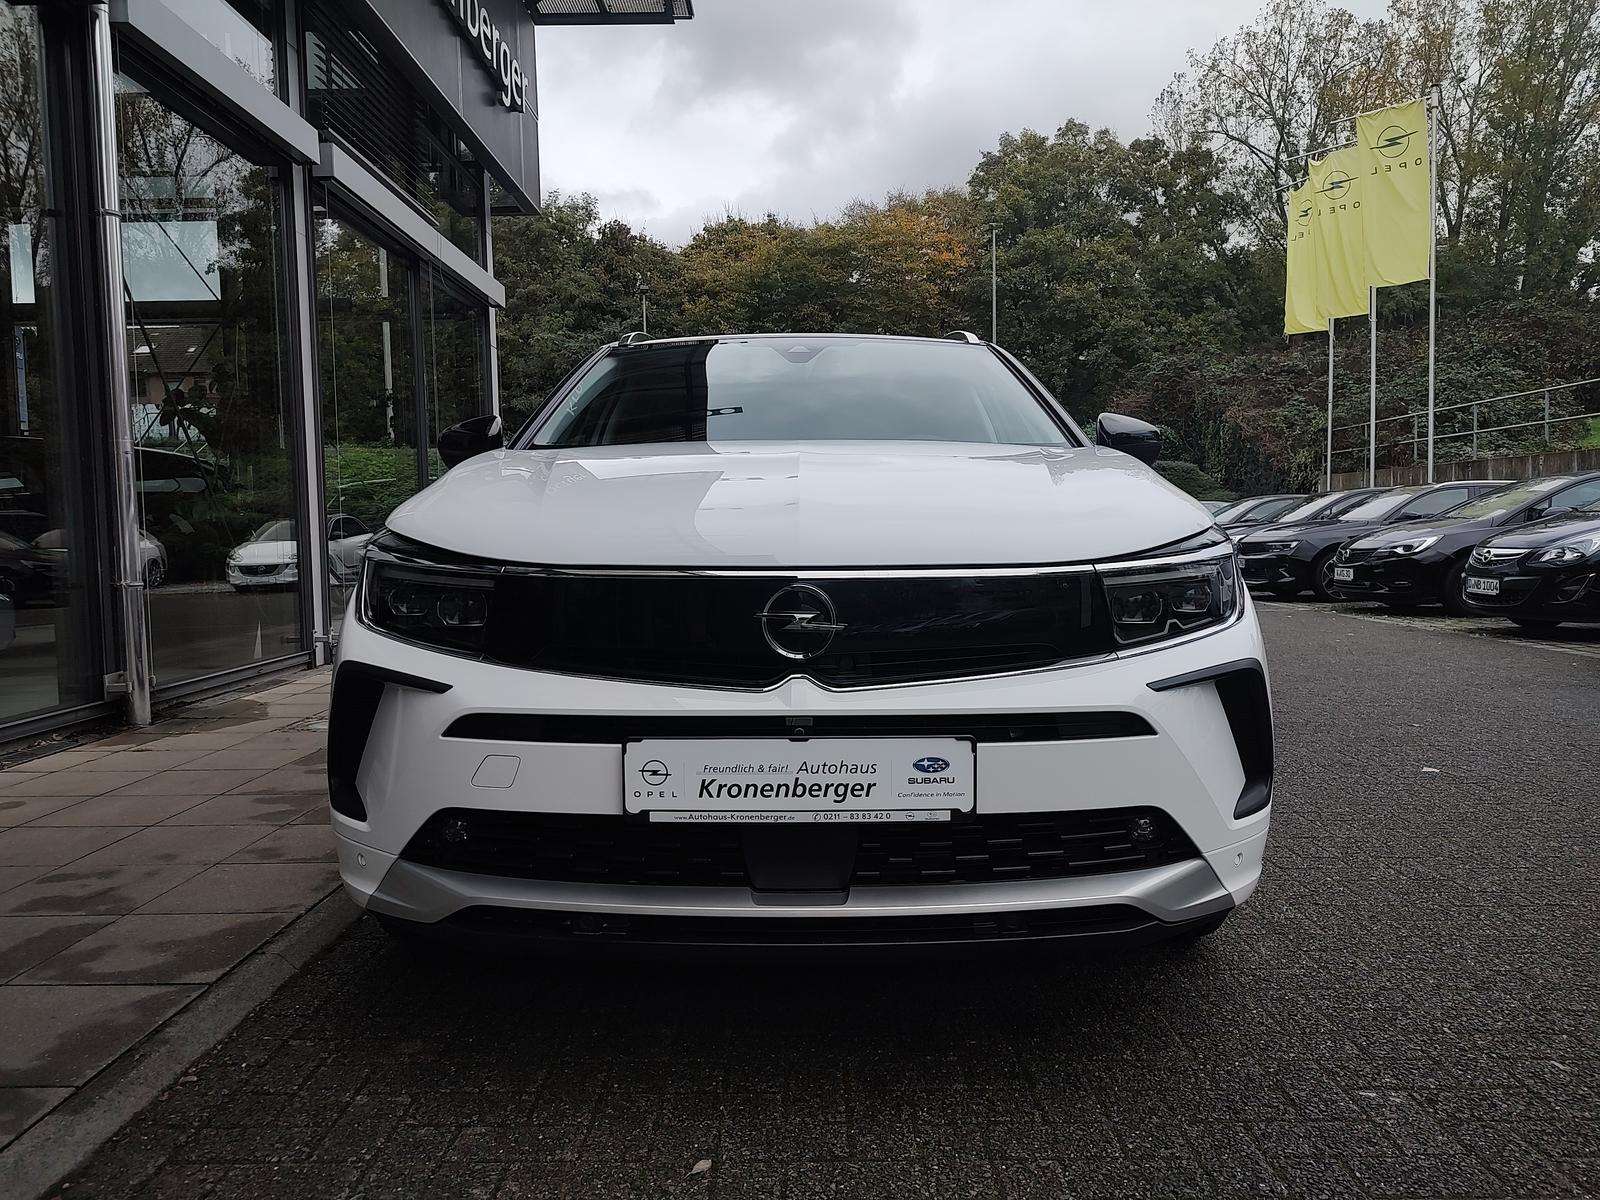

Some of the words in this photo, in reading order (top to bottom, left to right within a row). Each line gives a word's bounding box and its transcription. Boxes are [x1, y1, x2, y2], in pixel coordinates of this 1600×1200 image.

[452, 0, 528, 113] berger
[703, 764, 754, 773] Freundlich
[757, 764, 765, 773] &
[768, 764, 789, 773] fair!
[796, 760, 878, 775] Autohaus
[633, 790, 678, 798] OPEL
[698, 777, 877, 803] Kronenberger
[673, 813, 796, 822] www.Autohaus-Kronenberger.de
[823, 812, 841, 820] 0211
